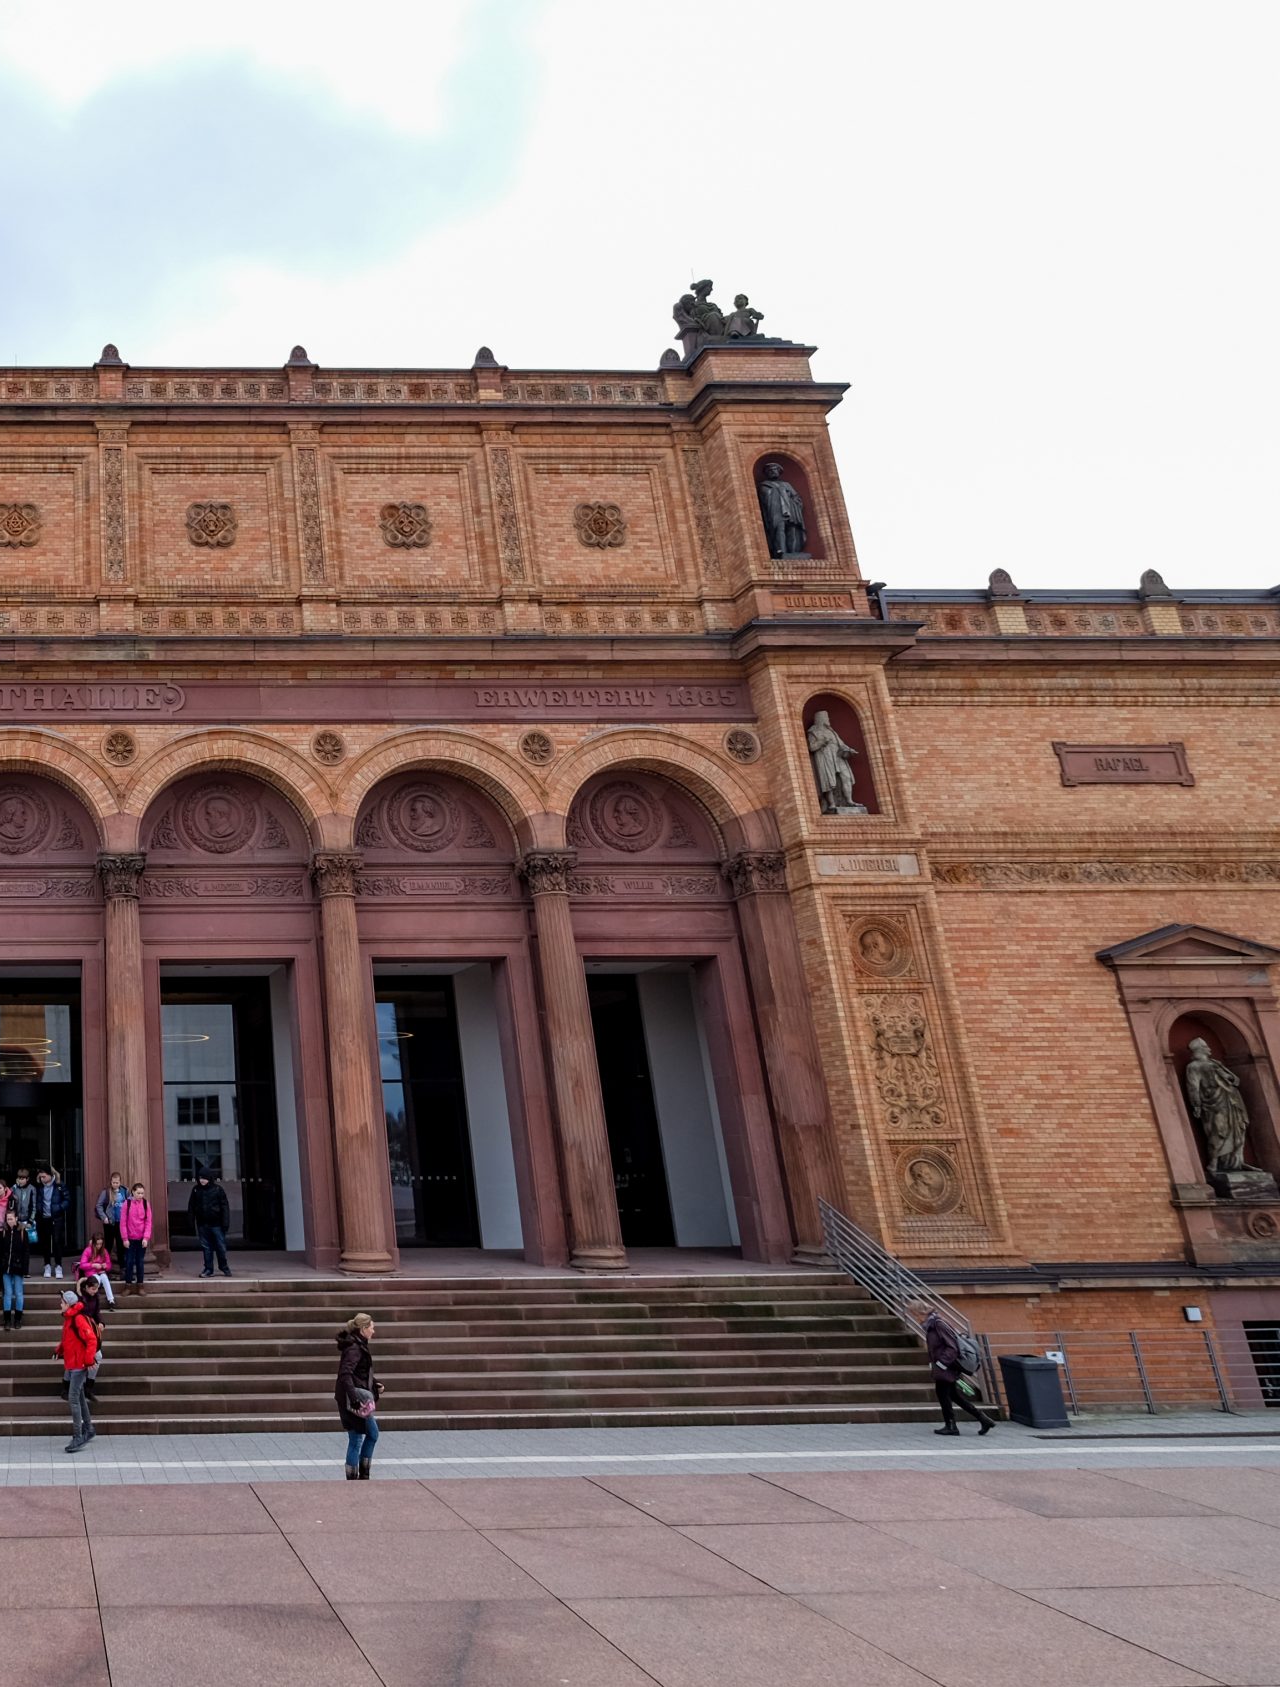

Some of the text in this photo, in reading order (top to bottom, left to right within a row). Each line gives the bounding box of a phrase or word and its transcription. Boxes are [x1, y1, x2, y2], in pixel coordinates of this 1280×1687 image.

[784, 596, 844, 608] HOLBEIN
[474, 687, 737, 708] ERWEITERT 1885
